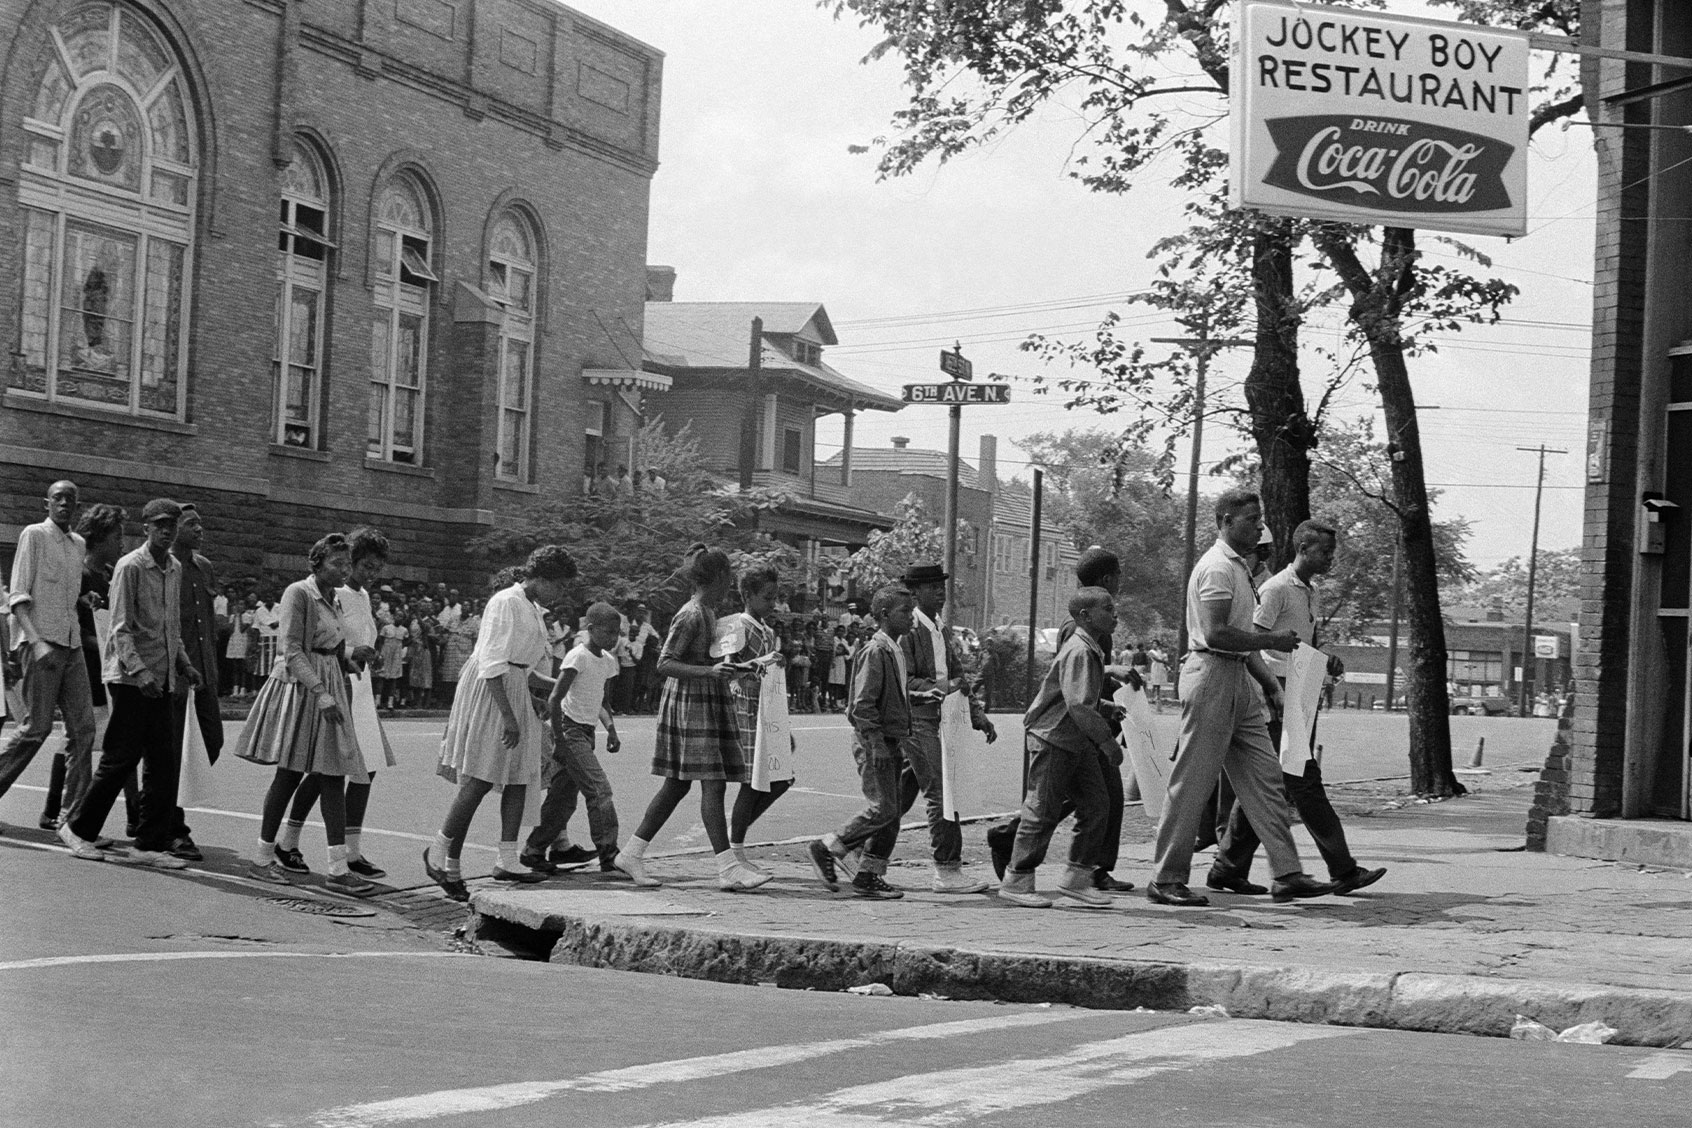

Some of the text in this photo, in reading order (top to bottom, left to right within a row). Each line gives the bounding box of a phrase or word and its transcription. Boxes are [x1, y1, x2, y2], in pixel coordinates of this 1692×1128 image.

[1266, 17, 1503, 73] JOCKEY BOY
[1258, 54, 1522, 115] RESTAURANT
[1350, 118, 1411, 136] DRINK
[1296, 126, 1485, 204] Coca-Cola
[911, 385, 1000, 401] 6TH AVE. N.
